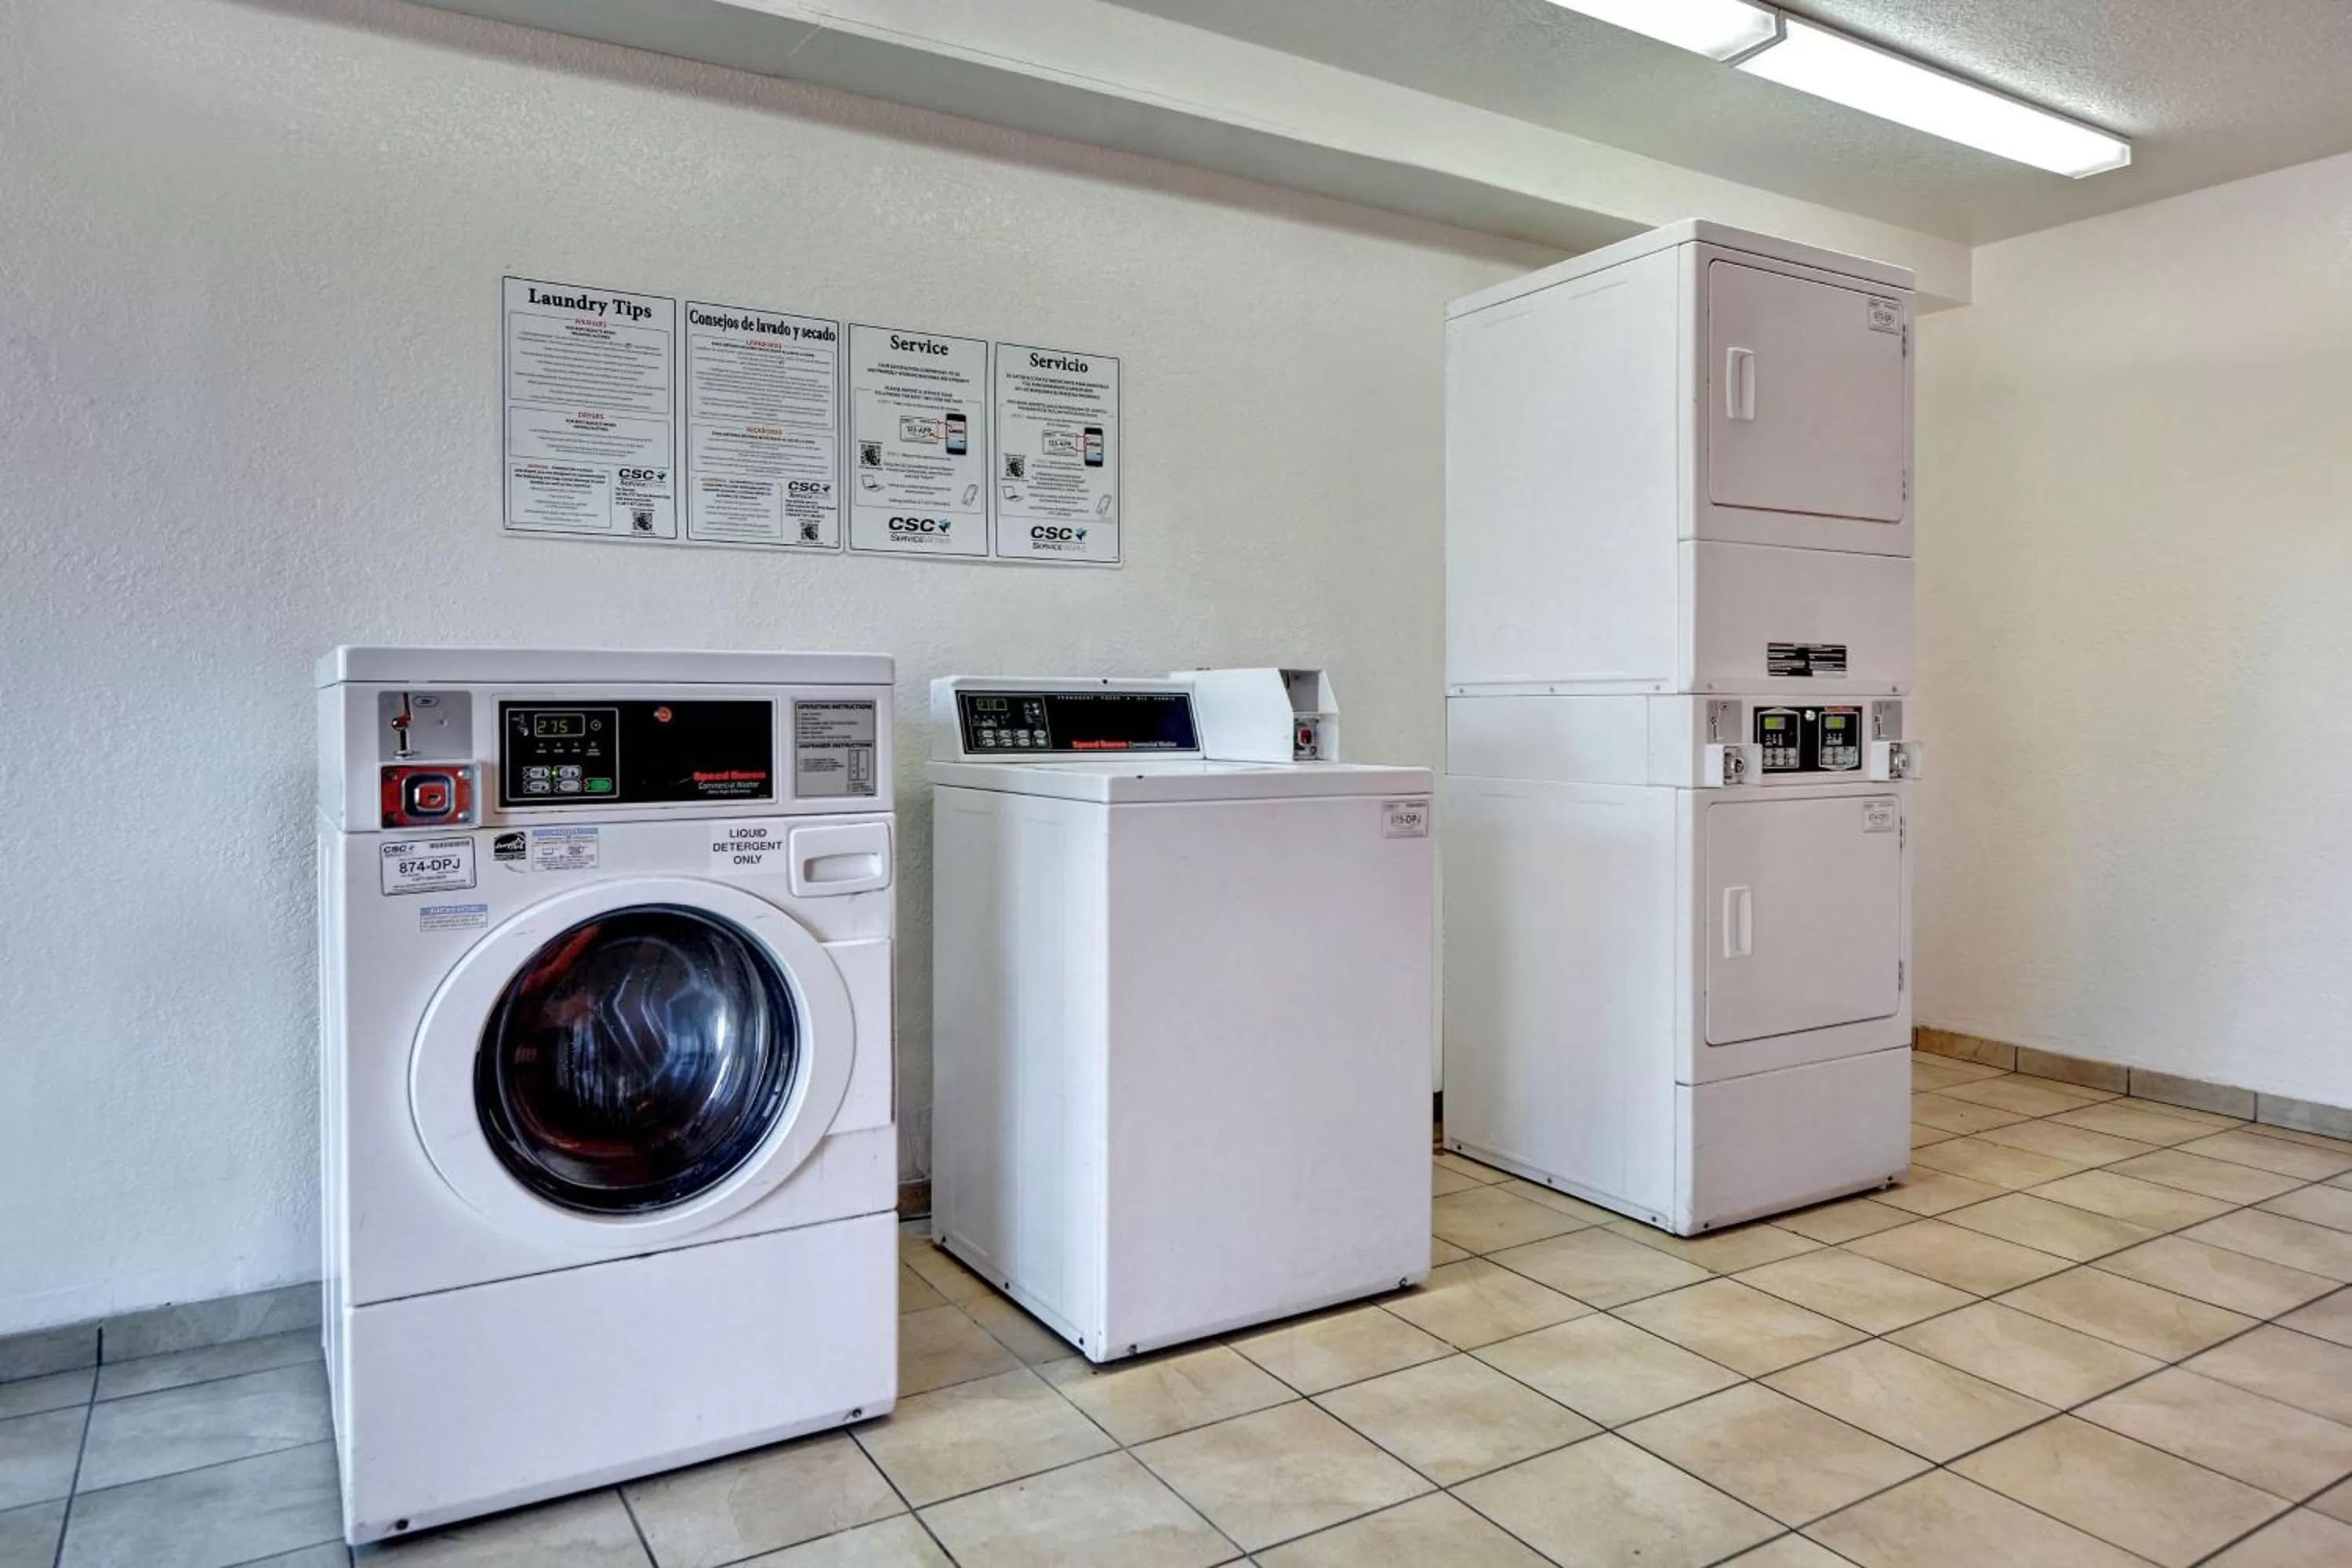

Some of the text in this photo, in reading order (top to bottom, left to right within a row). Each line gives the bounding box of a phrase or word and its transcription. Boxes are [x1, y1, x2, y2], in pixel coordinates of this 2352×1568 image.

[528, 288, 652, 321] Laundry Tips
[689, 310, 836, 341] Consejos de lavado y secado
[891, 335, 949, 355] Service
[1029, 353, 1089, 373] Servicio
[619, 469, 654, 480] CSC
[789, 481, 821, 492] CSC
[889, 517, 935, 532] CSC
[1031, 526, 1073, 540] CSC
[729, 829, 768, 838] LIQUID
[713, 841, 782, 852] DETERGENT
[399, 858, 461, 874] 874-DPJ
[733, 855, 763, 865] ONLY
